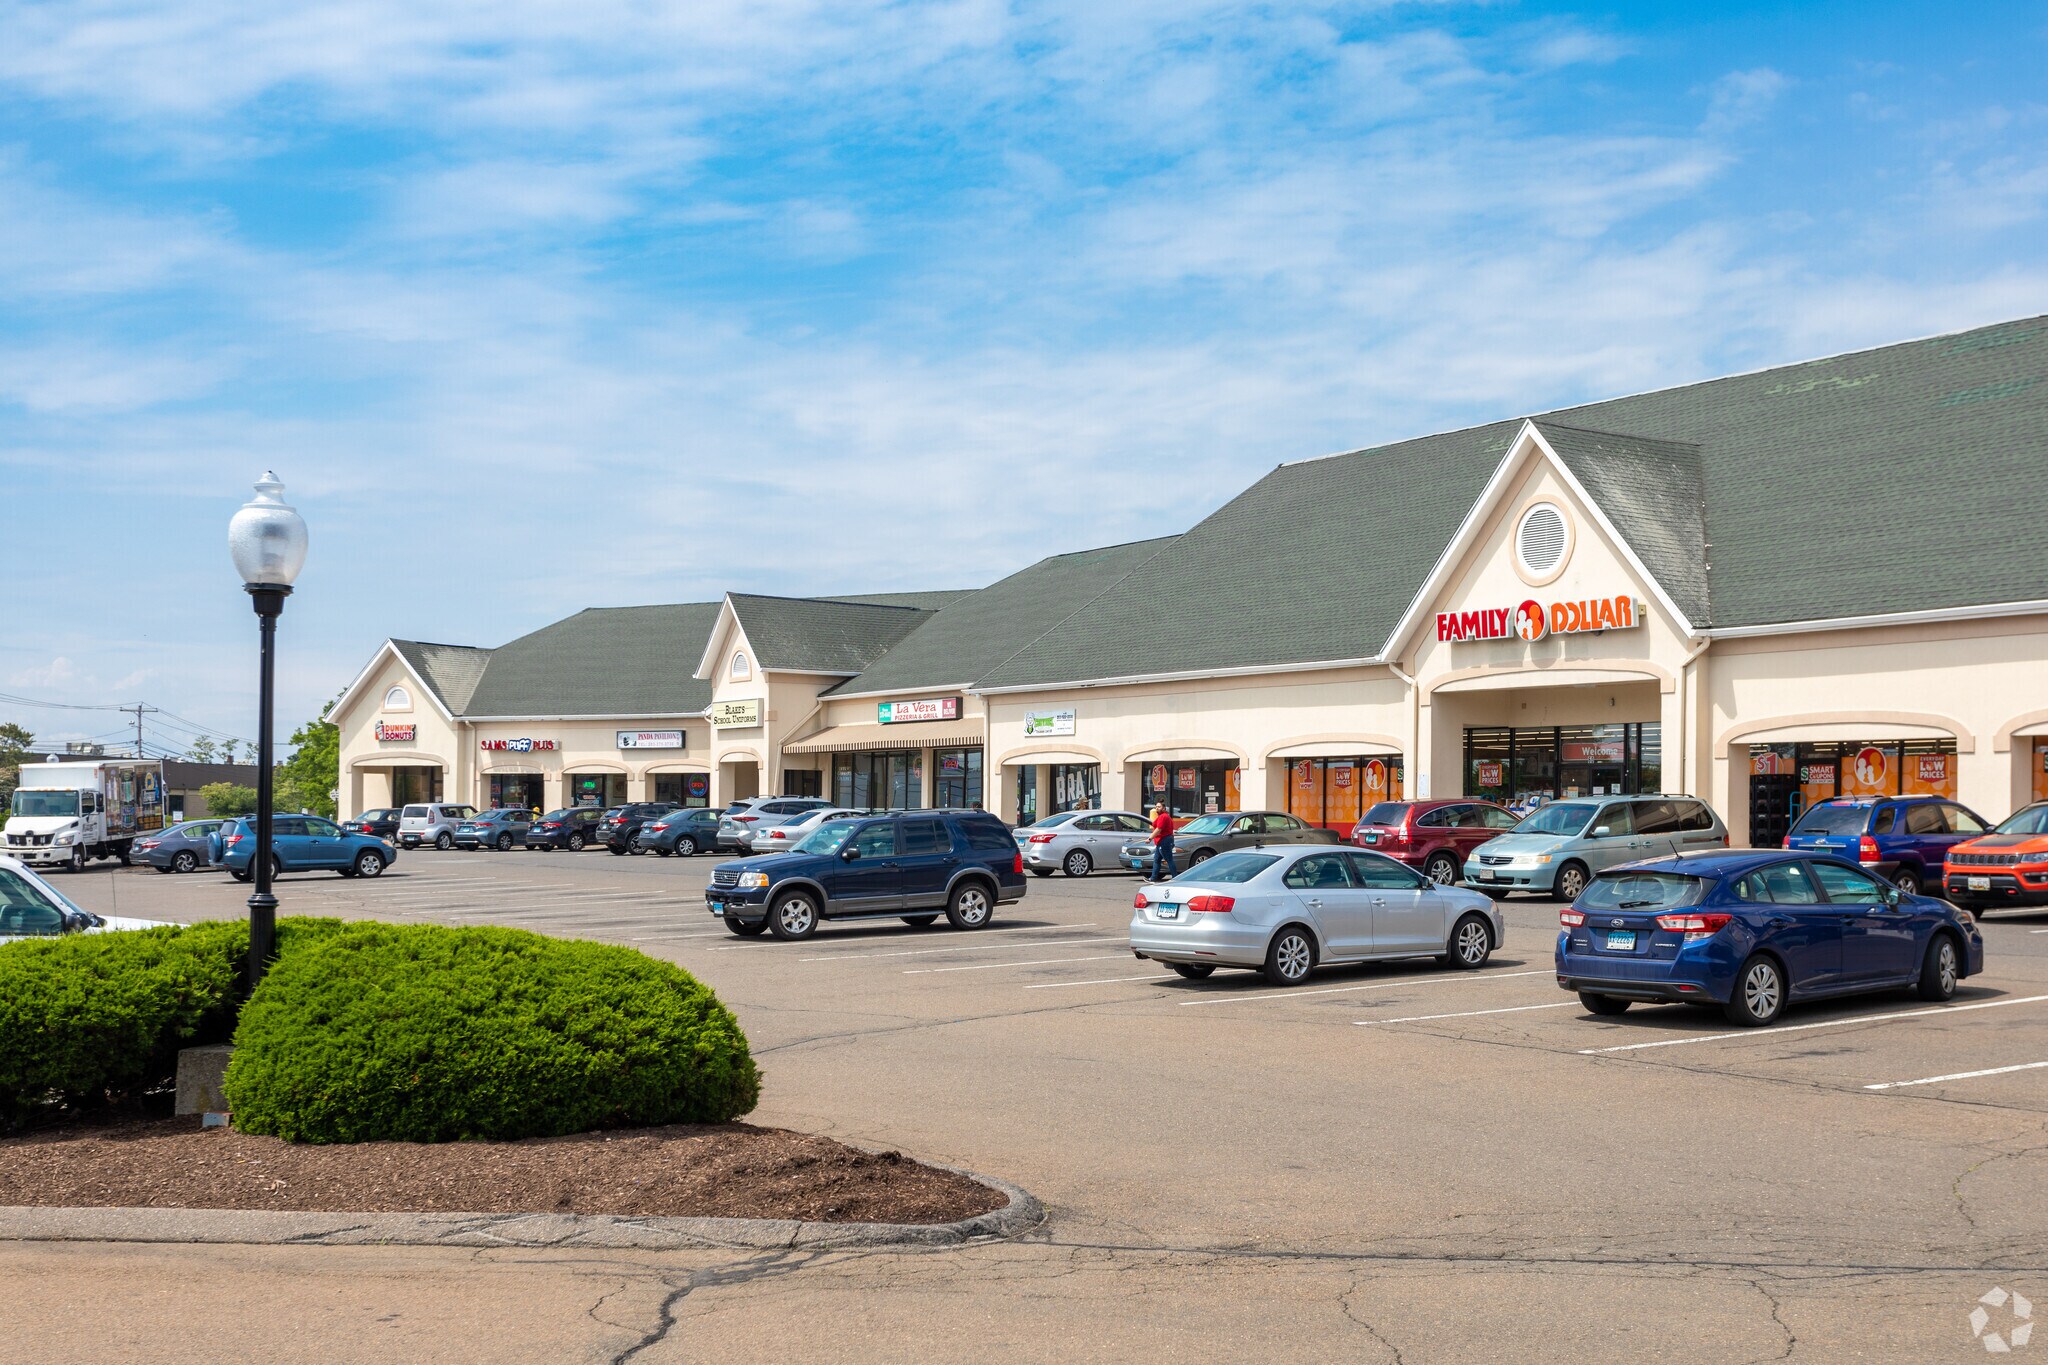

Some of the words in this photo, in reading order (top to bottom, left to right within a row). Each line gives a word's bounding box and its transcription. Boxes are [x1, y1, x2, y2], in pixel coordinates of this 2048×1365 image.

[1437, 608, 1510, 642] FAMILY
[1551, 595, 1632, 633] DOLLAR
[896, 704, 909, 714] La
[912, 702, 937, 713] Vera
[714, 716, 731, 725] SCHOOL
[732, 715, 757, 723] UNIFORMS
[385, 732, 413, 740] DONUTS
[481, 740, 507, 751] SAMS
[533, 740, 555, 751] PLUS
[1582, 746, 1618, 756] Welcome
[1757, 753, 1778, 774] $1
[1920, 761, 1945, 771] LOW
[1298, 761, 1313, 783] $1
[1482, 769, 1498, 777] LOW
[1809, 766, 1835, 774] SMART
[1920, 771, 1945, 779] PRICES
[1153, 765, 1165, 786] $1
[1181, 773, 1193, 781] LOW
